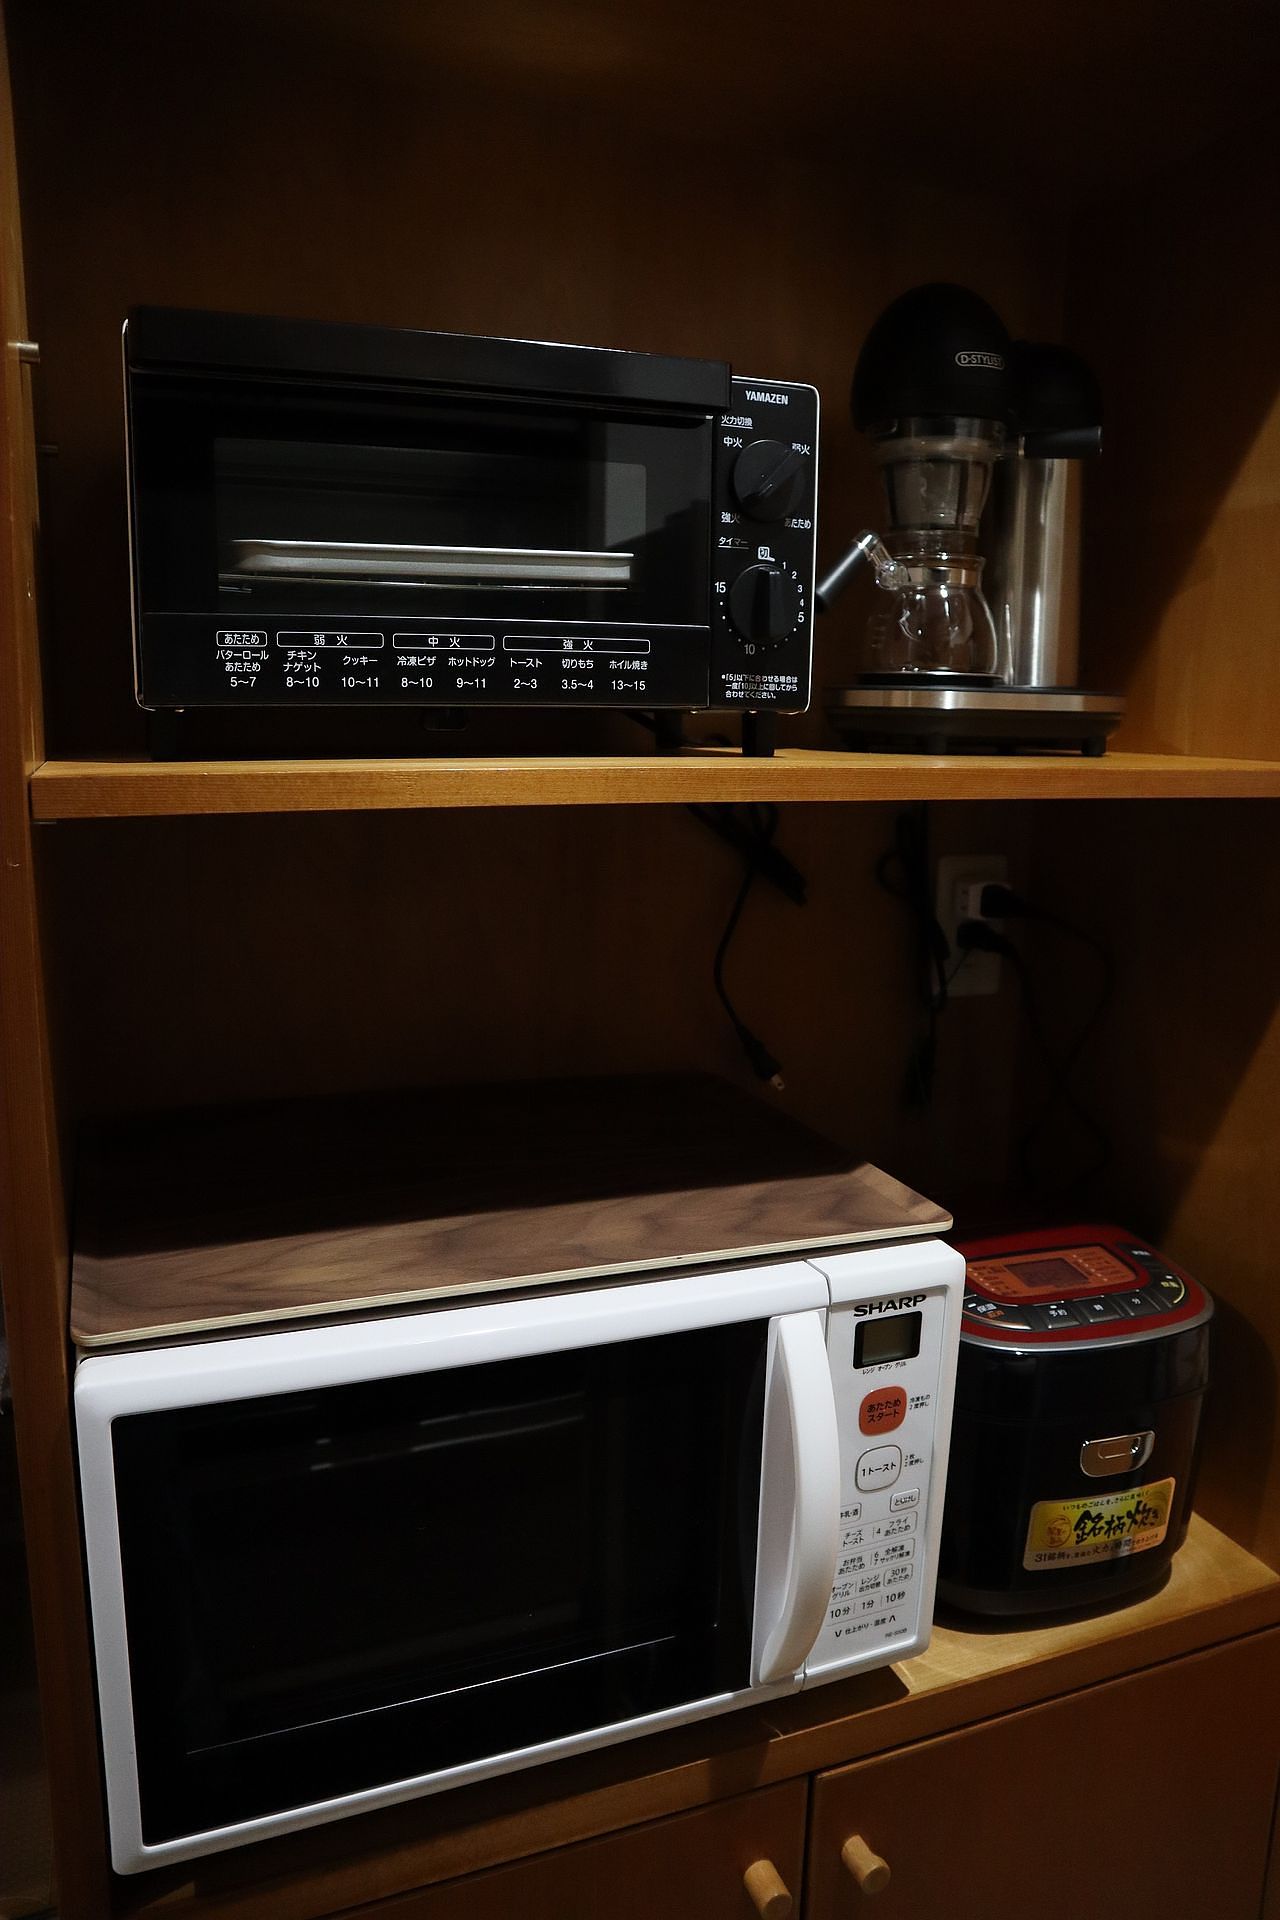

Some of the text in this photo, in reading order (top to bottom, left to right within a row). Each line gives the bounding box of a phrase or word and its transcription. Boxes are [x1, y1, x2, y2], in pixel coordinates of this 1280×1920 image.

[745, 390, 789, 405] YAMAZEN
[721, 415, 753, 427] 火力切換
[723, 436, 743, 448] 中火
[720, 511, 741, 524] 強火
[718, 536, 749, 545] タイマー
[791, 571, 797, 579] 2
[714, 582, 726, 593] 15
[797, 612, 805, 622] 5
[224, 633, 260, 645] あたため
[216, 650, 269, 660] バターロール
[744, 644, 755, 655] 10
[287, 651, 317, 660] チキン
[343, 655, 378, 665] クッキー
[397, 656, 436, 666] 冷凍ピザ
[224, 662, 261, 672] あたため
[448, 656, 495, 667] ホットドッグ
[510, 658, 543, 668] トースト
[562, 658, 594, 669] 切りもち
[609, 660, 648, 670] ホイル焼き
[283, 662, 321, 673] ナゲット
[853, 1294, 927, 1317] SHARP
[867, 1398, 902, 1412] あたため
[868, 1408, 900, 1423] スタート
[889, 1517, 909, 1528] フライ
[845, 1530, 863, 1539] チーズ
[884, 1524, 911, 1537] あたため
[843, 1537, 865, 1547] トースト
[838, 1563, 866, 1575] あたため
[886, 1591, 906, 1604] 10秒
[862, 1599, 875, 1610] 1分
[830, 1606, 851, 1618] 10分
